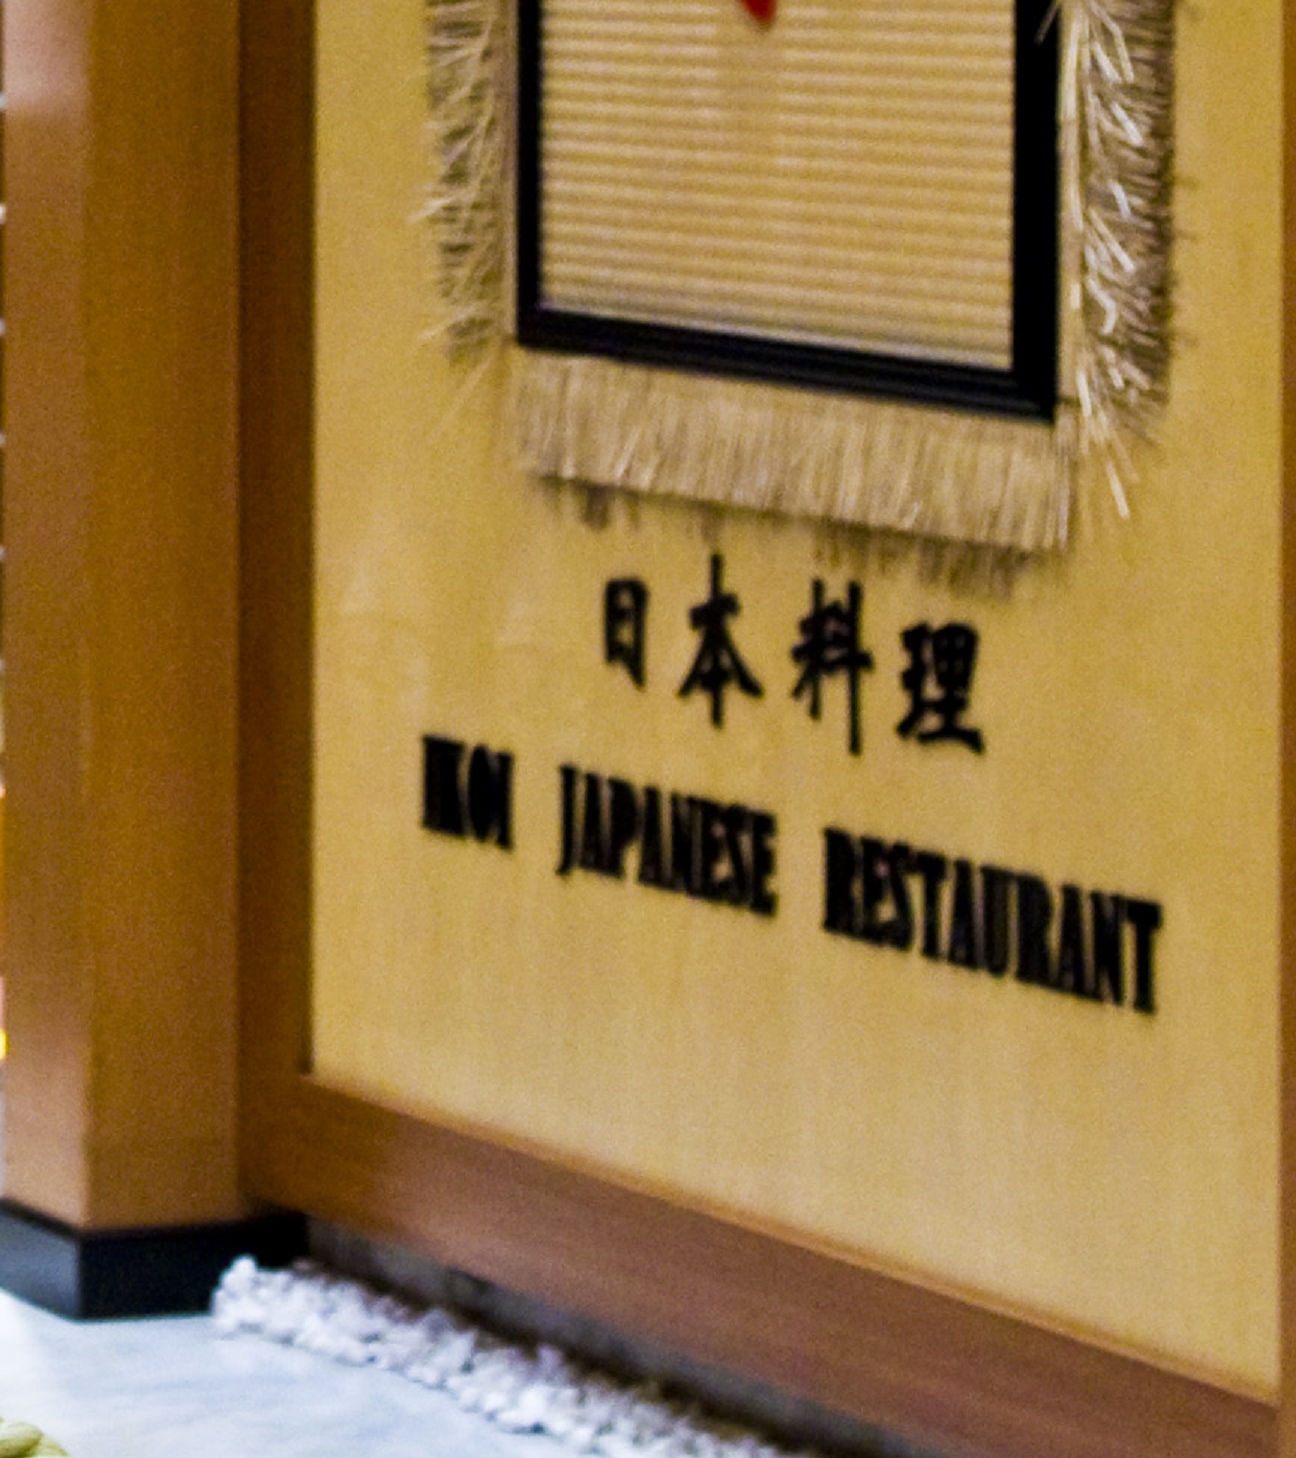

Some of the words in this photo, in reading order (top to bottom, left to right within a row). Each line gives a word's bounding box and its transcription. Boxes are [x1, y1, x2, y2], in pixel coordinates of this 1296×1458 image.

[602, 553, 986, 757] 日本料理
[420, 734, 514, 852] IKOI
[556, 762, 779, 920] JAPANESE
[822, 824, 1165, 1016] RESTAURANT
